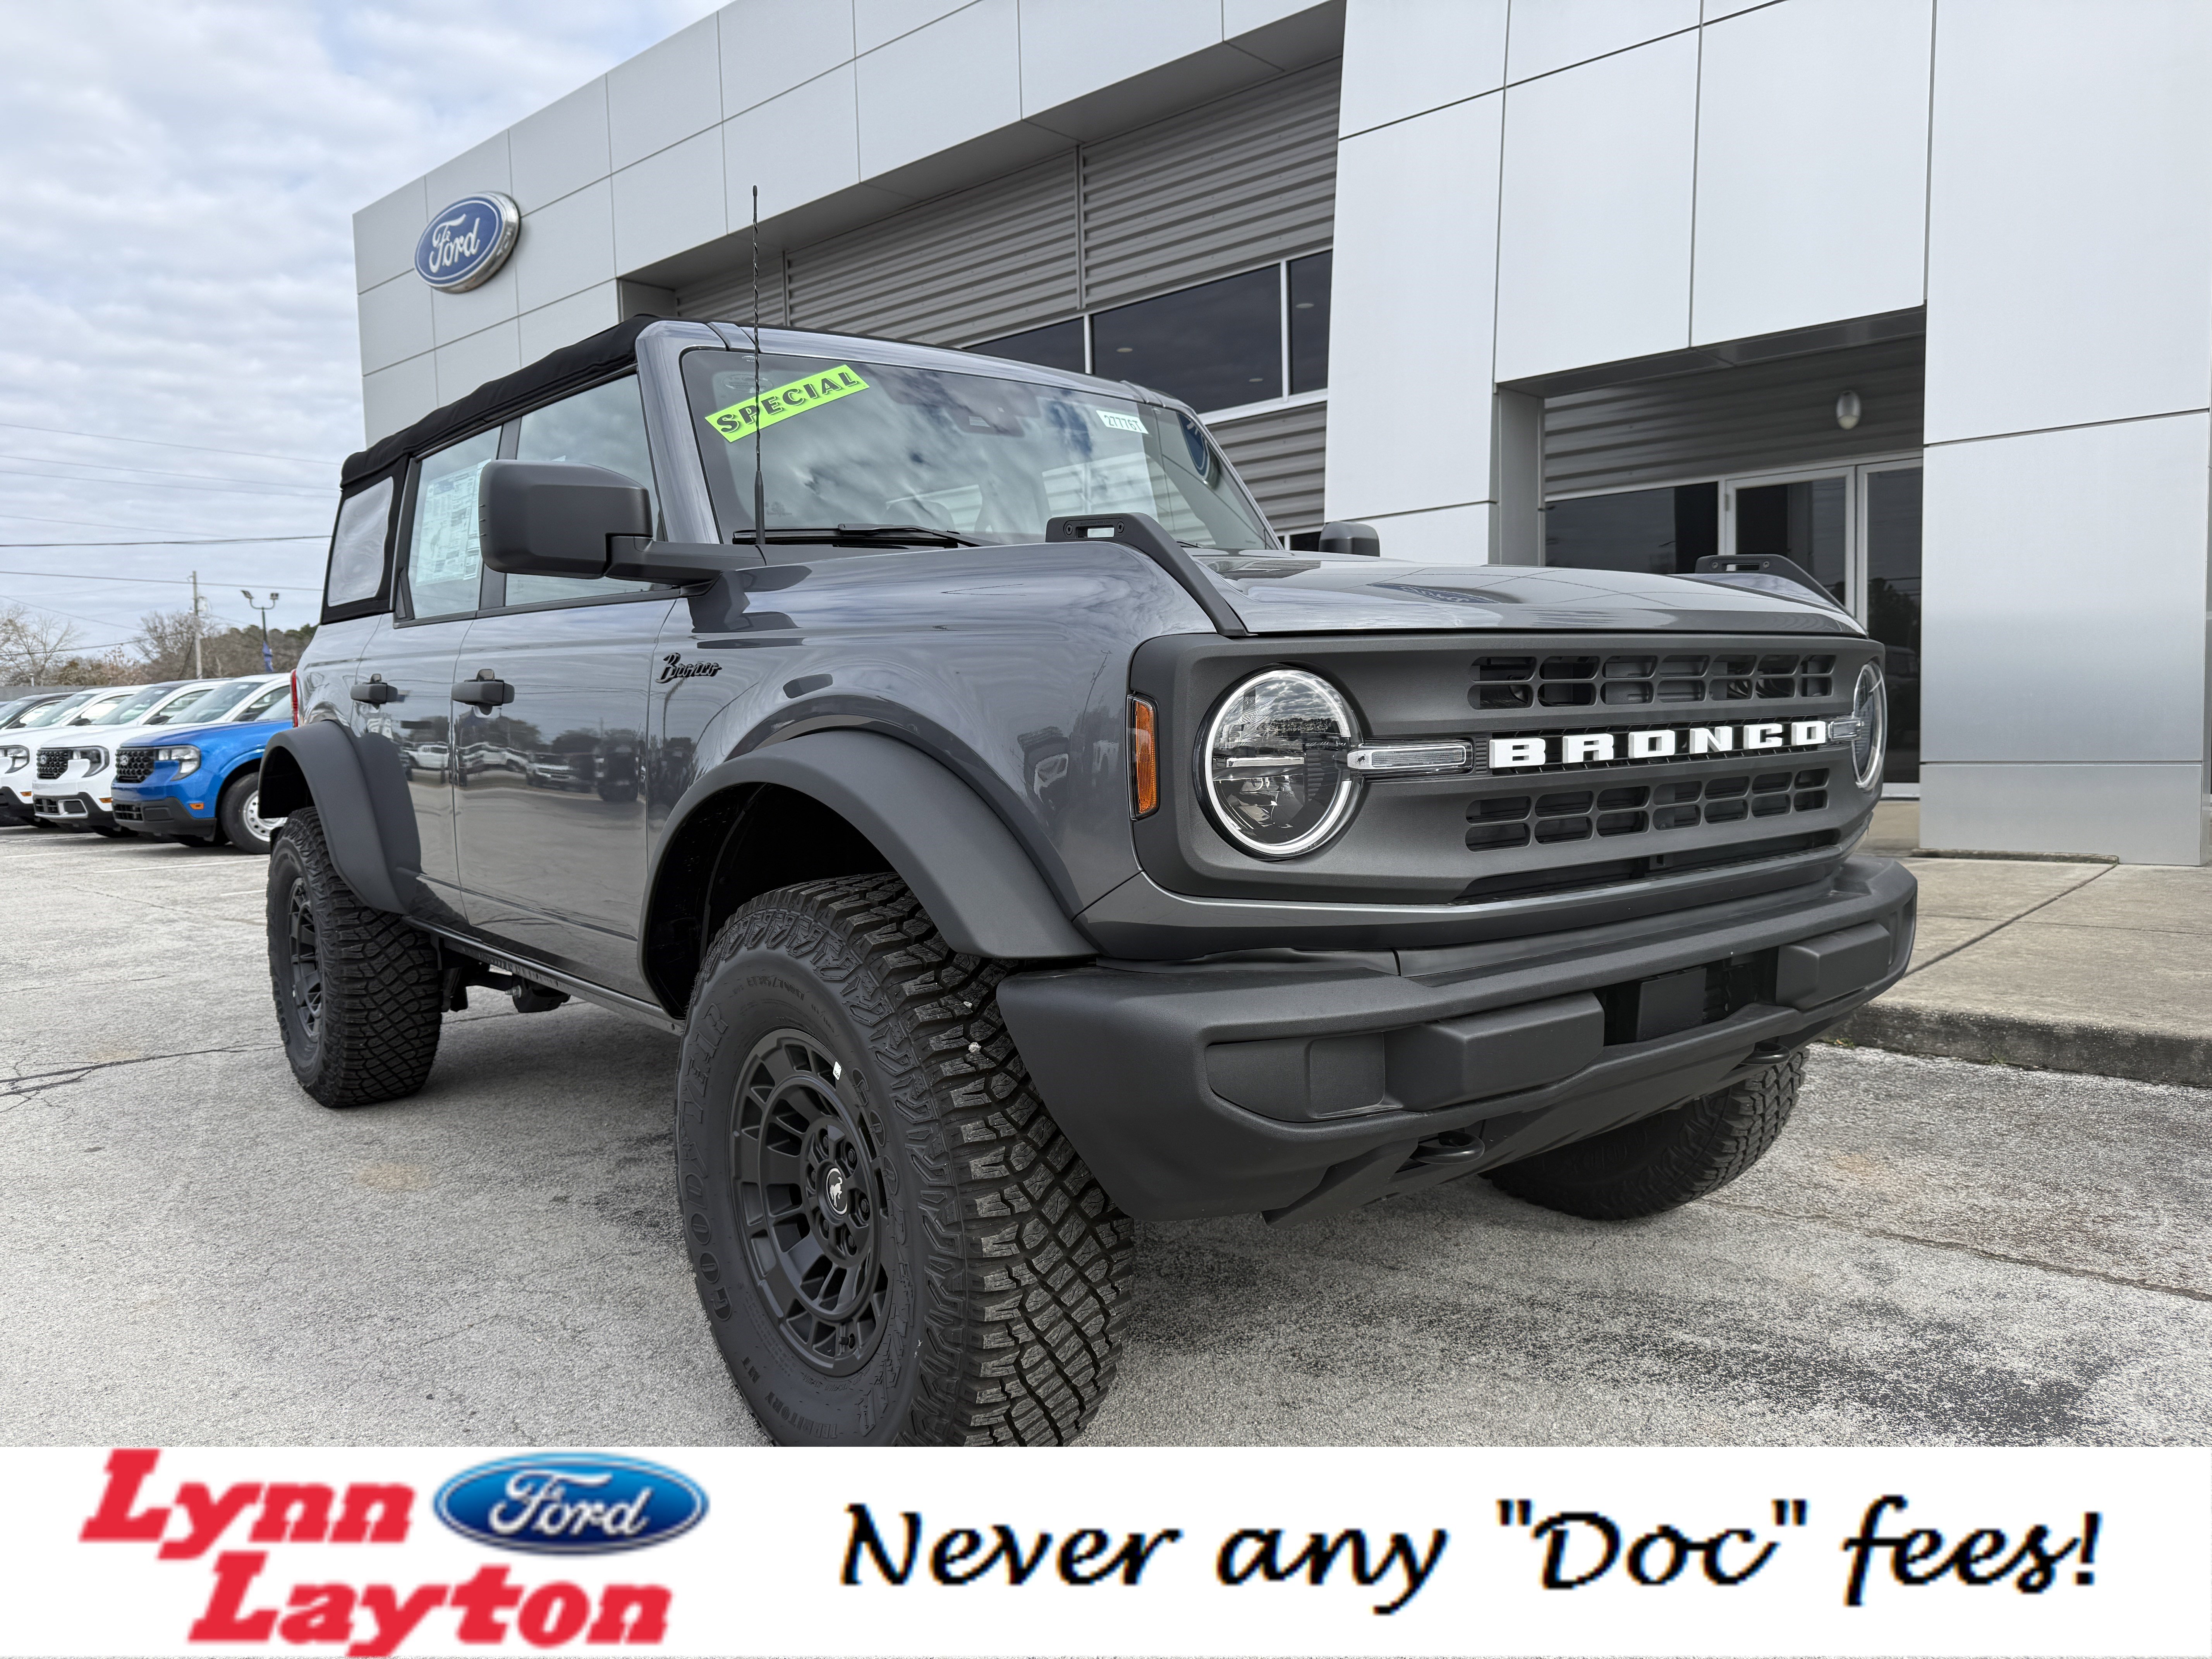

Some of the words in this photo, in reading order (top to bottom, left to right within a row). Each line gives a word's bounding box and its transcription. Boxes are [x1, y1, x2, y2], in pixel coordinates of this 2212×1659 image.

[429, 213, 480, 273] Ford
[716, 372, 857, 433] SPECIAL
[1104, 415, 1142, 431] 27776T
[655, 652, 723, 684] Bronco
[1489, 720, 1826, 768] BRONCO
[764, 1391, 838, 1439] TERRITORY
